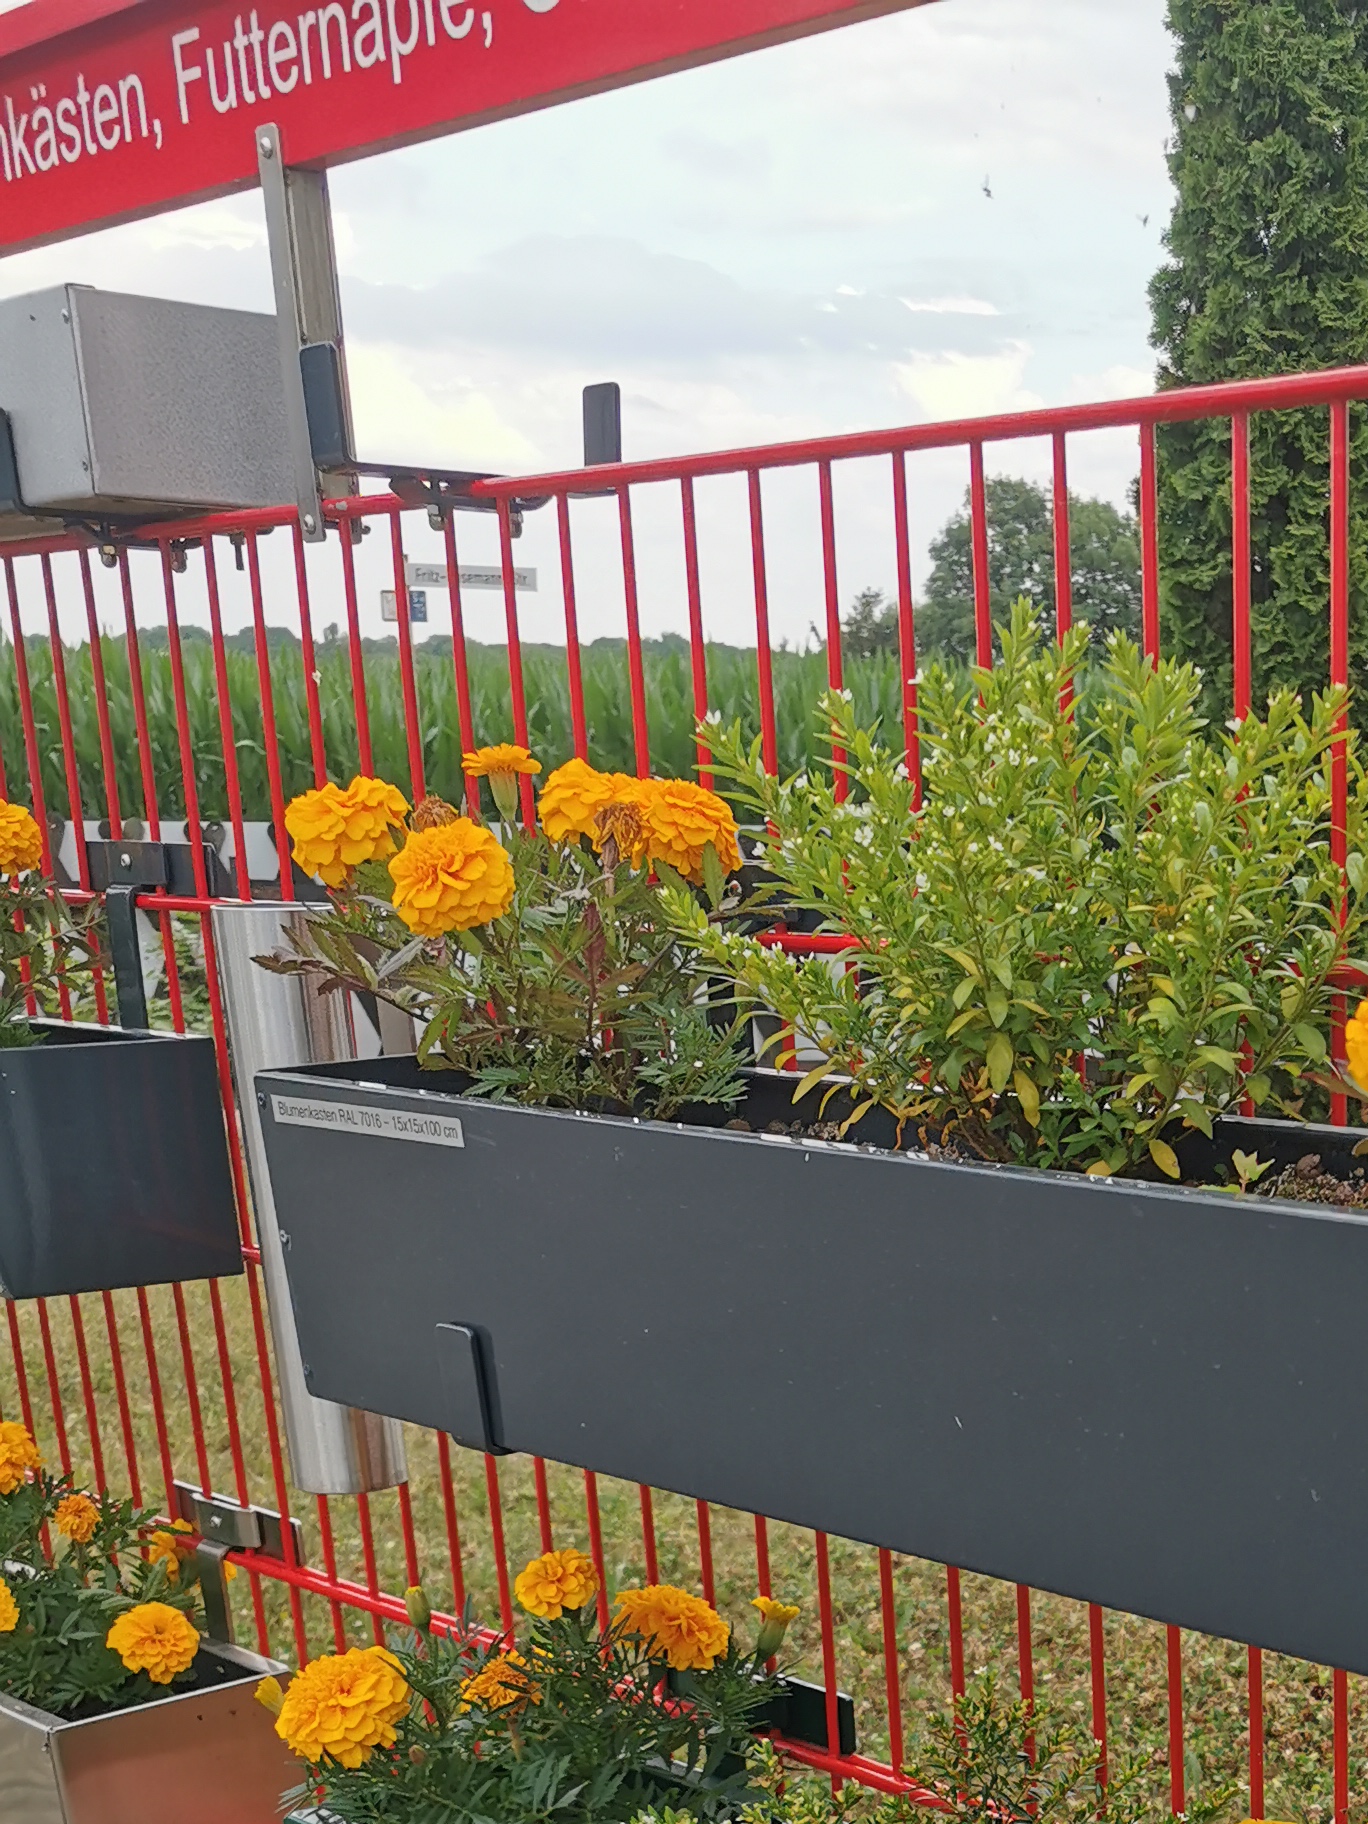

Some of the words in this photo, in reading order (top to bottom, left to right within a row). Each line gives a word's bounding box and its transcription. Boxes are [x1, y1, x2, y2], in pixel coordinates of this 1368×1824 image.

[277, 1101, 338, 1123] Blumenkasten
[338, 1109, 358, 1125] RAL
[359, 1111, 382, 1128] 7016
[392, 1116, 441, 1136] 15x15x100
[443, 1126, 458, 1139] cm
